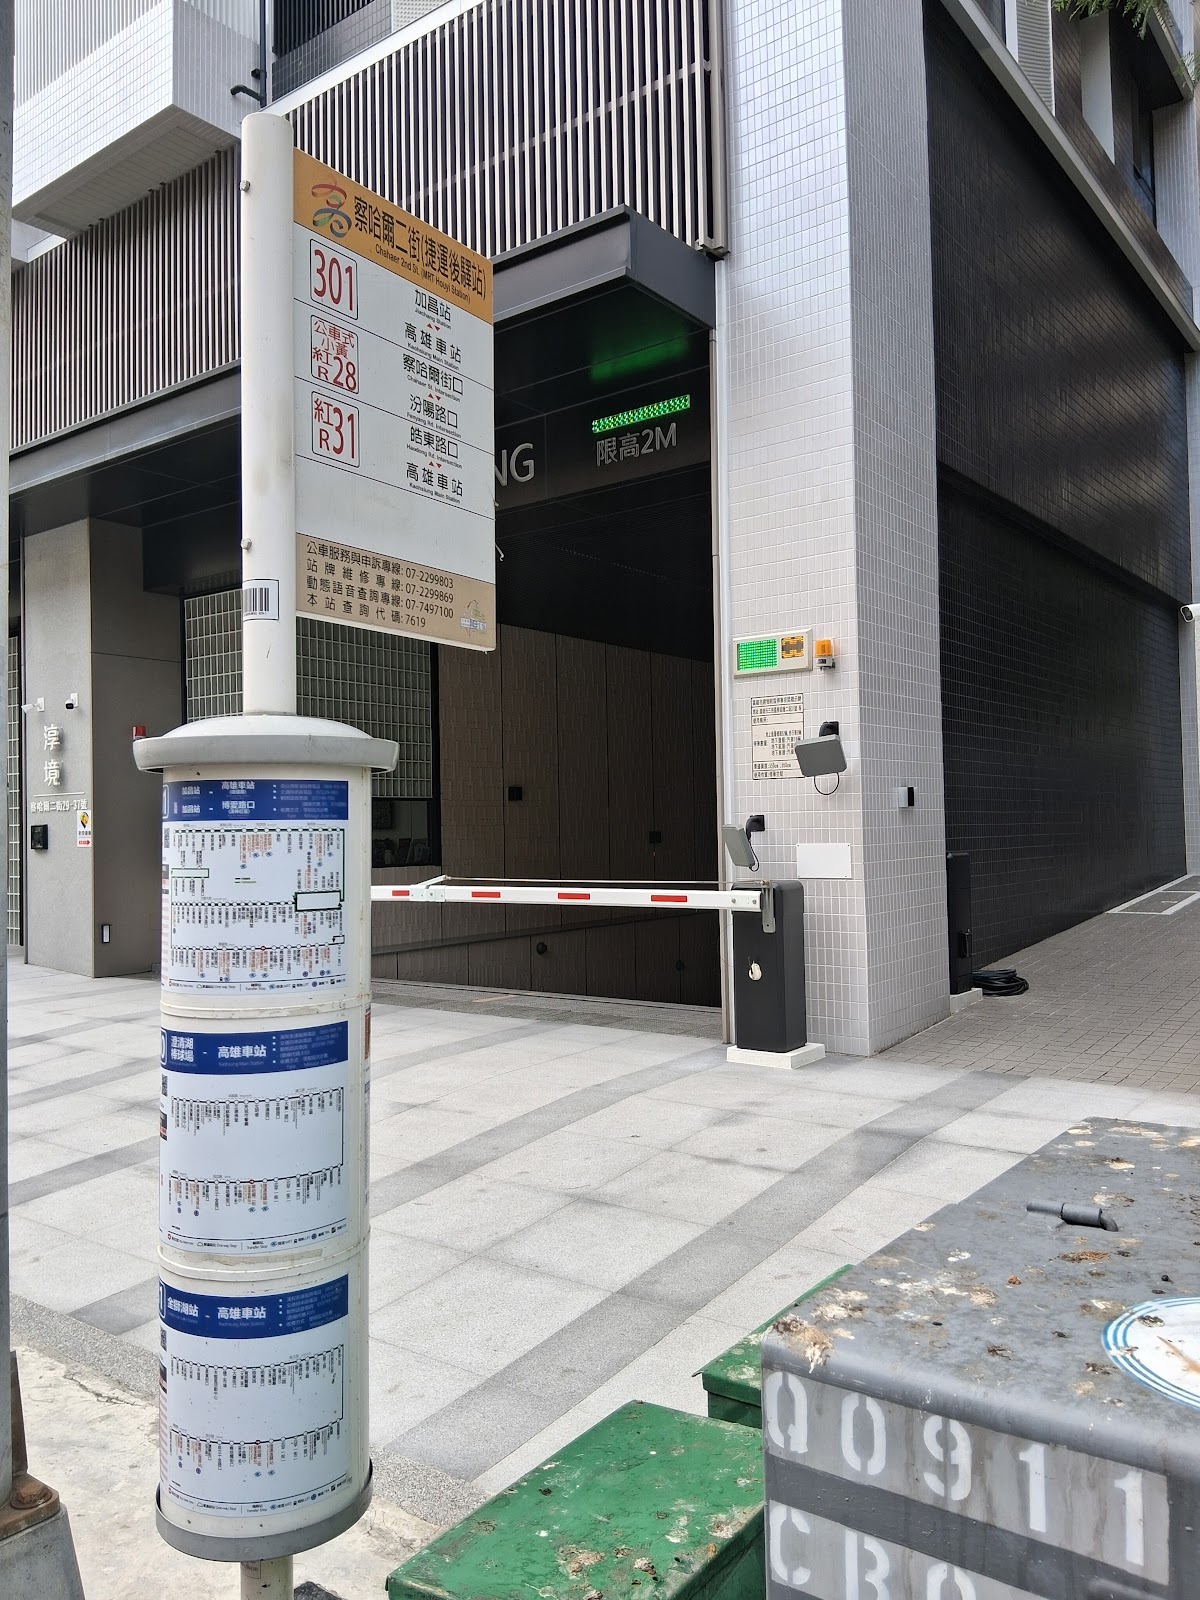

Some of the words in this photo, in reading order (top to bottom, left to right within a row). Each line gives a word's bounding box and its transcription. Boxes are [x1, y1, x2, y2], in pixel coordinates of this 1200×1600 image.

[354, 196, 486, 300] 察哈爾二街(捷運後驛站)
[314, 249, 353, 311] 301
[375, 244, 399, 264] Chahaer
[401, 257, 411, 270] 2nd
[412, 264, 420, 275] St.
[421, 268, 434, 283] (MRT
[436, 276, 450, 292] Houyi
[451, 284, 470, 304] Station)
[415, 289, 450, 322] 加昌站
[314, 320, 354, 348] 公車式
[436, 318, 451, 330] Station
[322, 338, 348, 359] 小黃
[405, 322, 461, 364] 高雄車站
[318, 365, 329, 381] R
[333, 356, 357, 391] 28
[403, 353, 463, 395] 察哈爾街口
[433, 354, 443, 365] Main
[444, 359, 459, 371] Station
[410, 393, 458, 429] 汾陽路口
[319, 428, 330, 452] R
[332, 406, 355, 459] 31
[410, 425, 458, 459] 皓東路口
[596, 422, 677, 467] 限高2M
[406, 462, 462, 497] 高雄車站
[434, 489, 445, 499] Main
[445, 494, 460, 504] Station
[405, 613, 426, 628] 7619
[221, 780, 255, 790] 高雄車站
[217, 1044, 267, 1059] 高雄車站
[167, 1296, 199, 1318] 金獅湖站
[217, 1305, 267, 1320] 高雄車站
